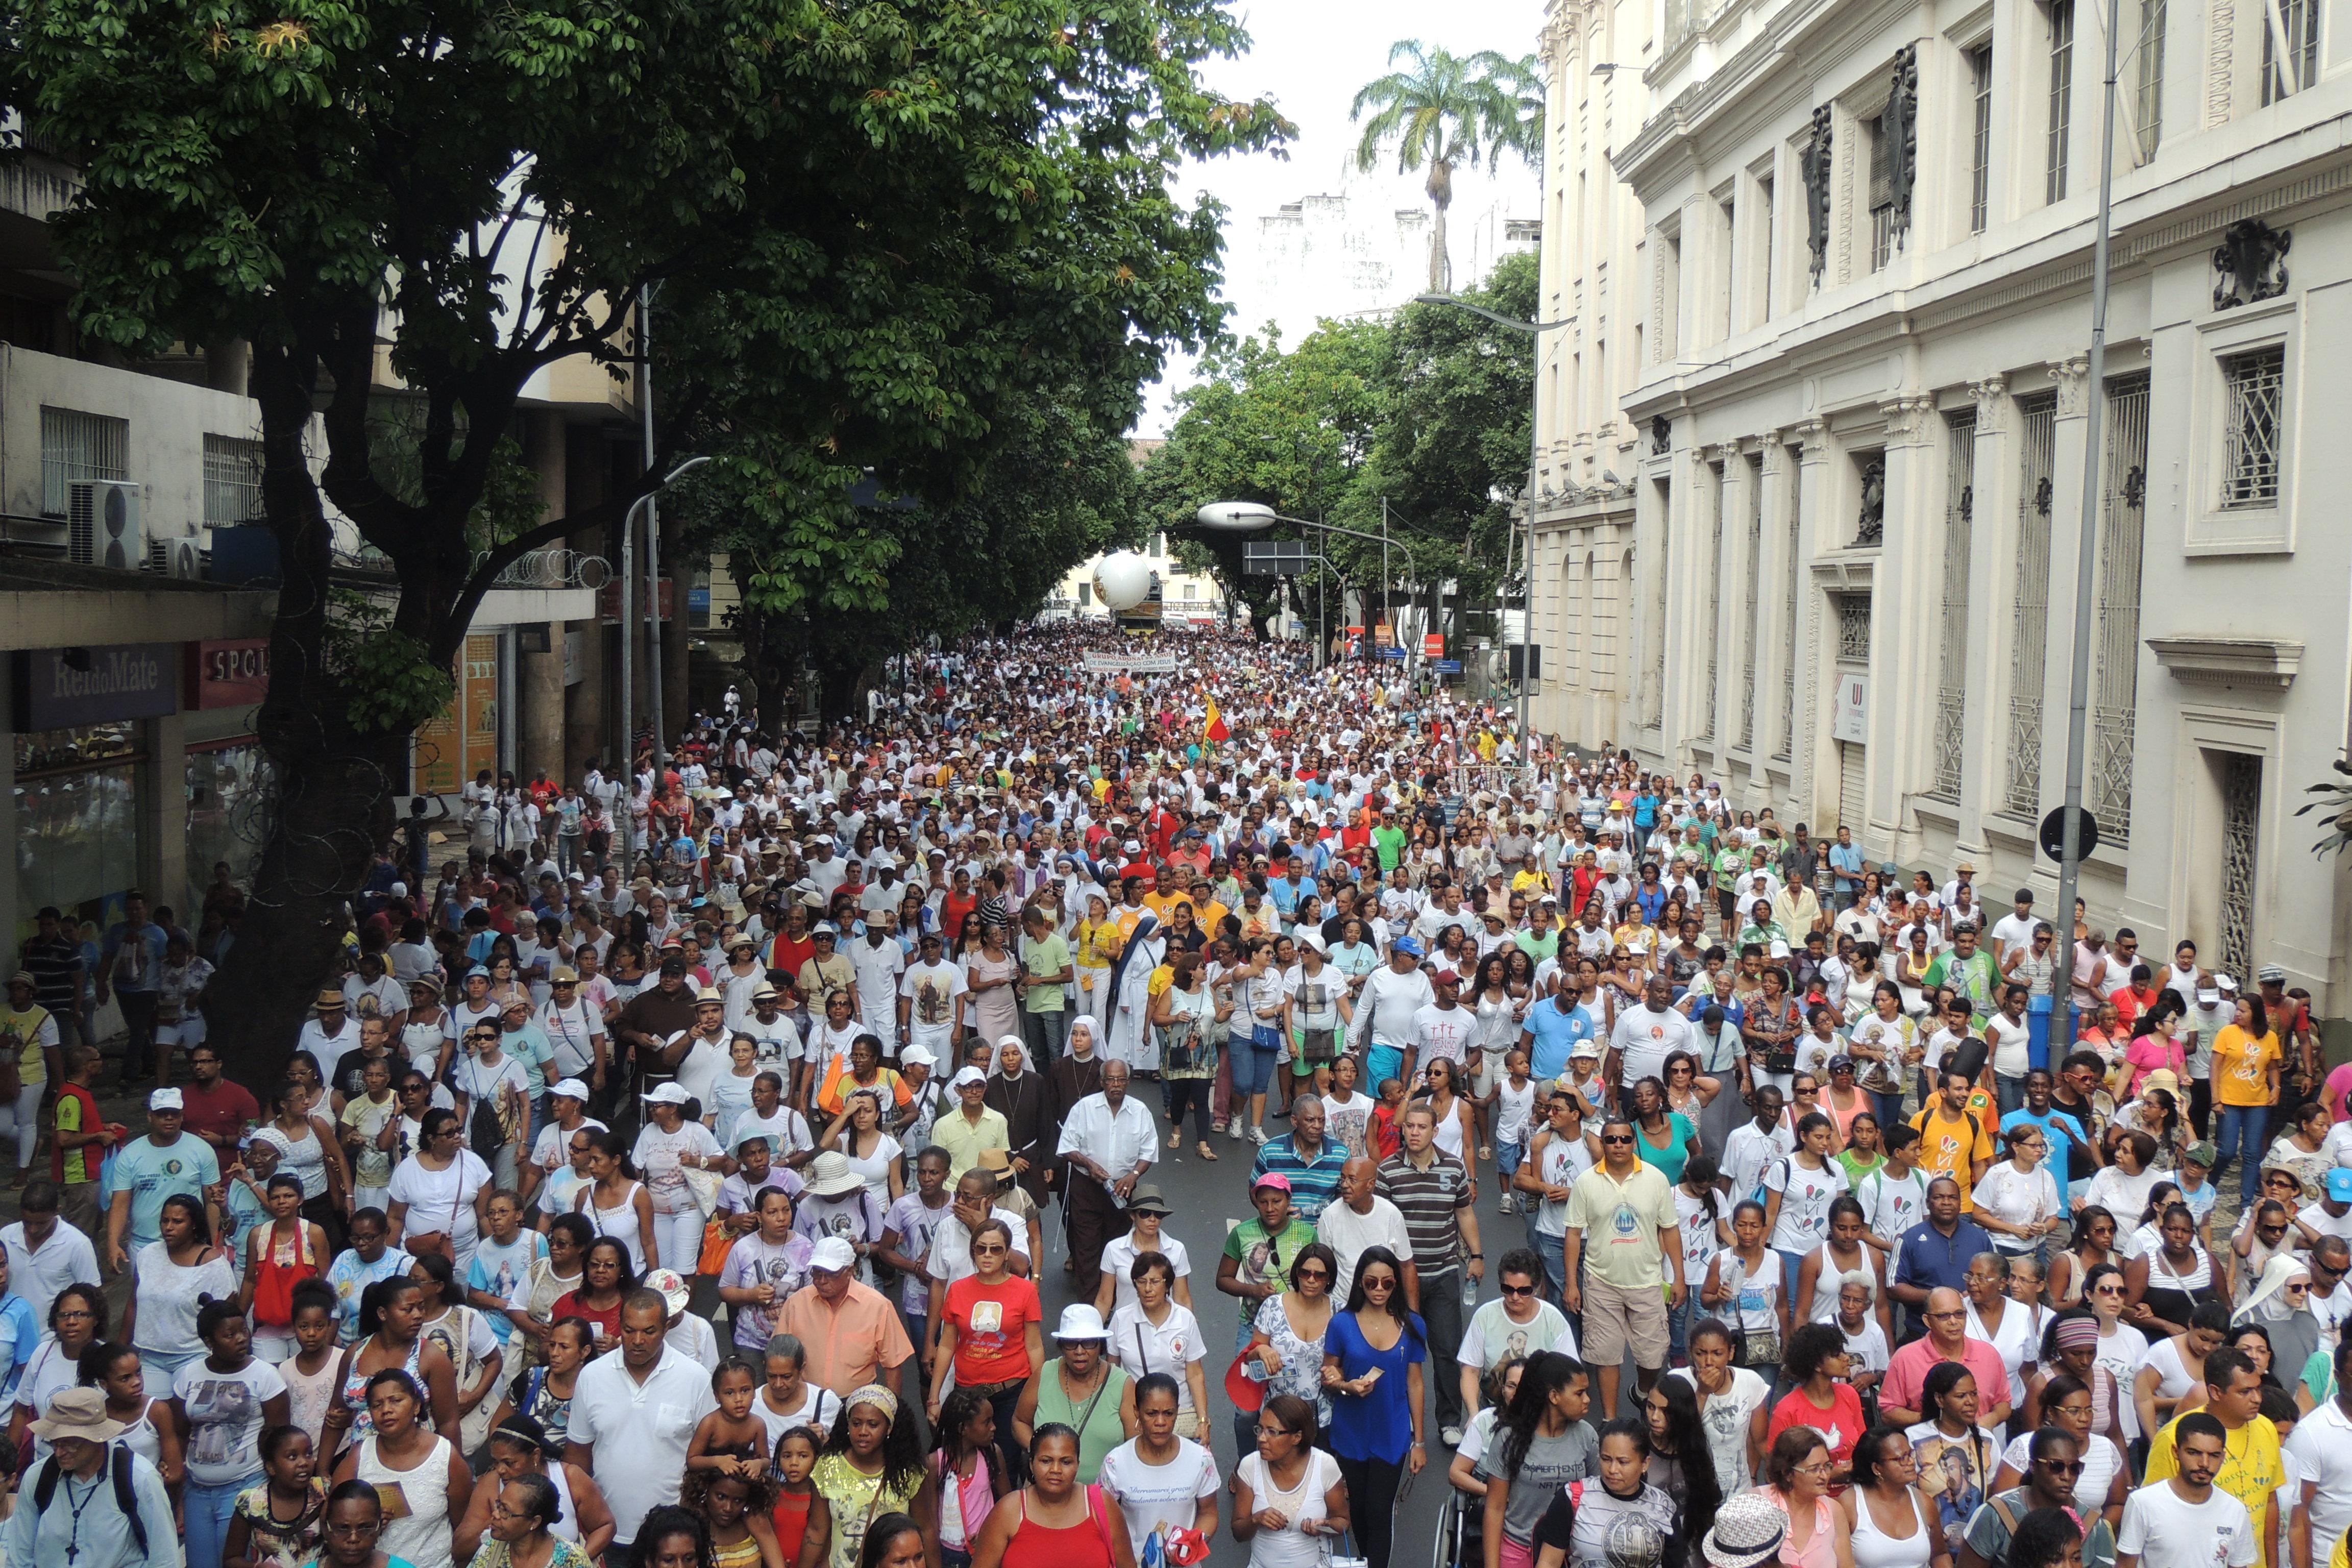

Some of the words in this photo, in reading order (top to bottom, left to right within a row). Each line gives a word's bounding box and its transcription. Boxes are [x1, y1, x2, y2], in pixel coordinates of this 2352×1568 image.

[1429, 1039, 1457, 1051] TENHO
[1440, 1172, 1452, 1191] 5
[1739, 1290, 1759, 1299] ONTE
